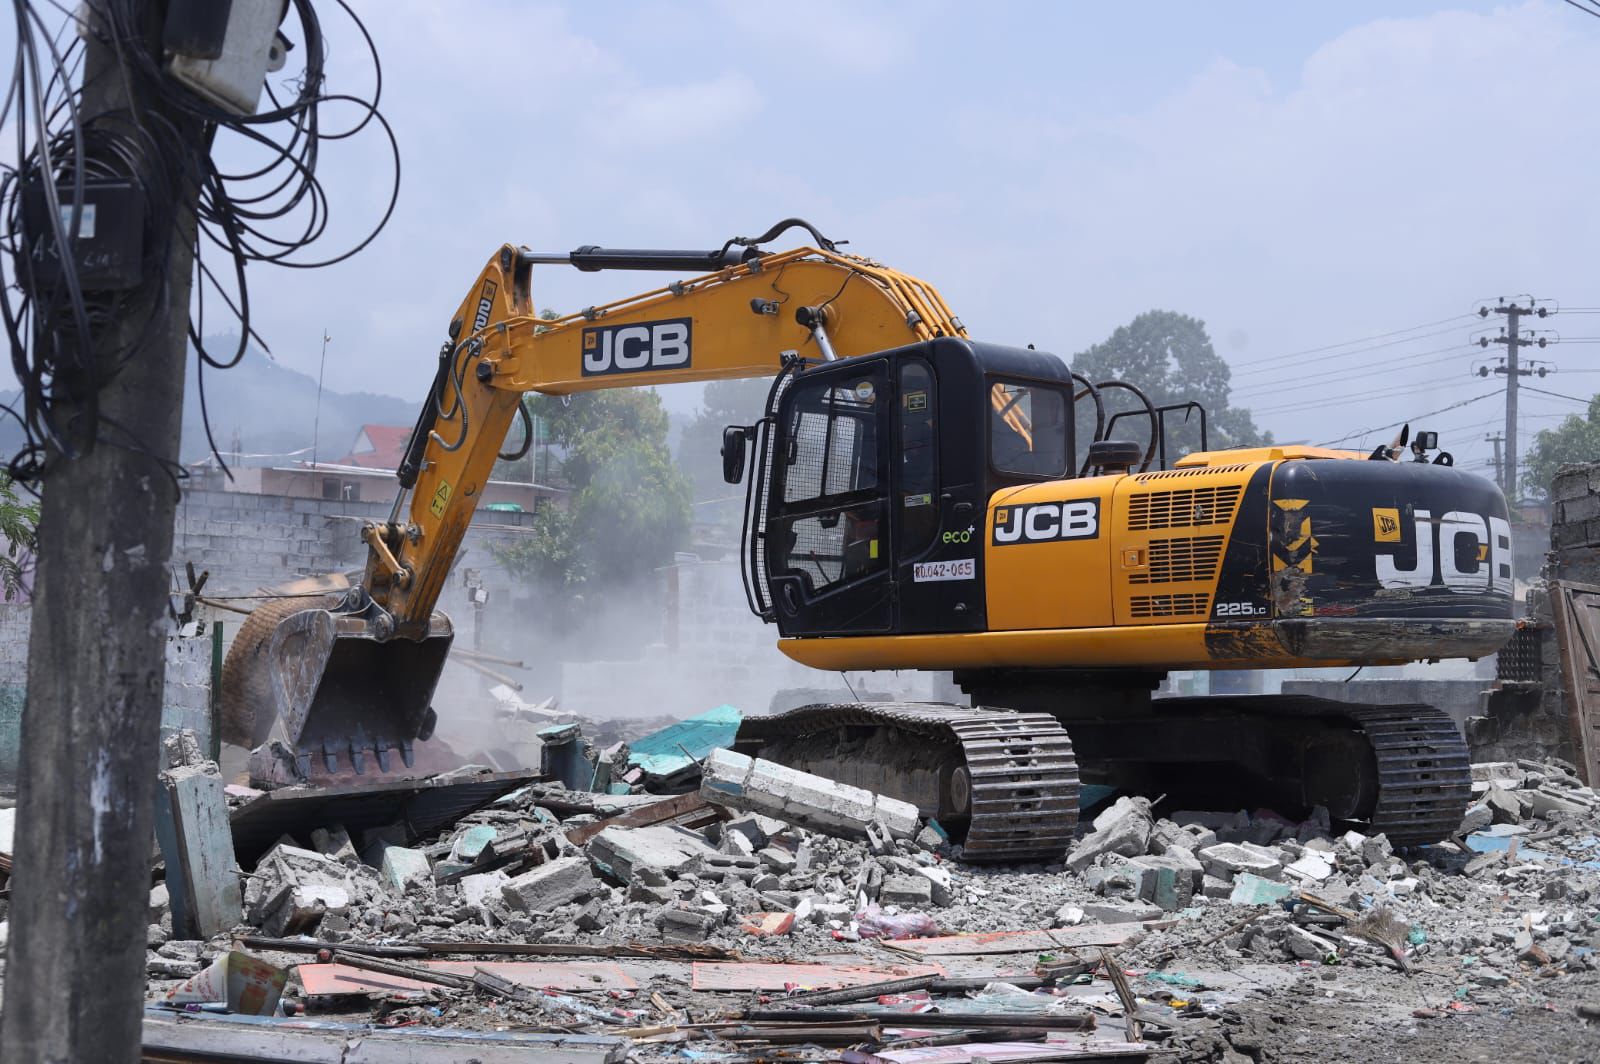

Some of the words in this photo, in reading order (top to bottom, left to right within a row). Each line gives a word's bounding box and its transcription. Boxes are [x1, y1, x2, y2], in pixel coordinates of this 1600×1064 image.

[584, 323, 689, 372] JCB
[995, 501, 1097, 542] JCB
[1380, 517, 1397, 533] JCB
[1375, 509, 1514, 596] JCB
